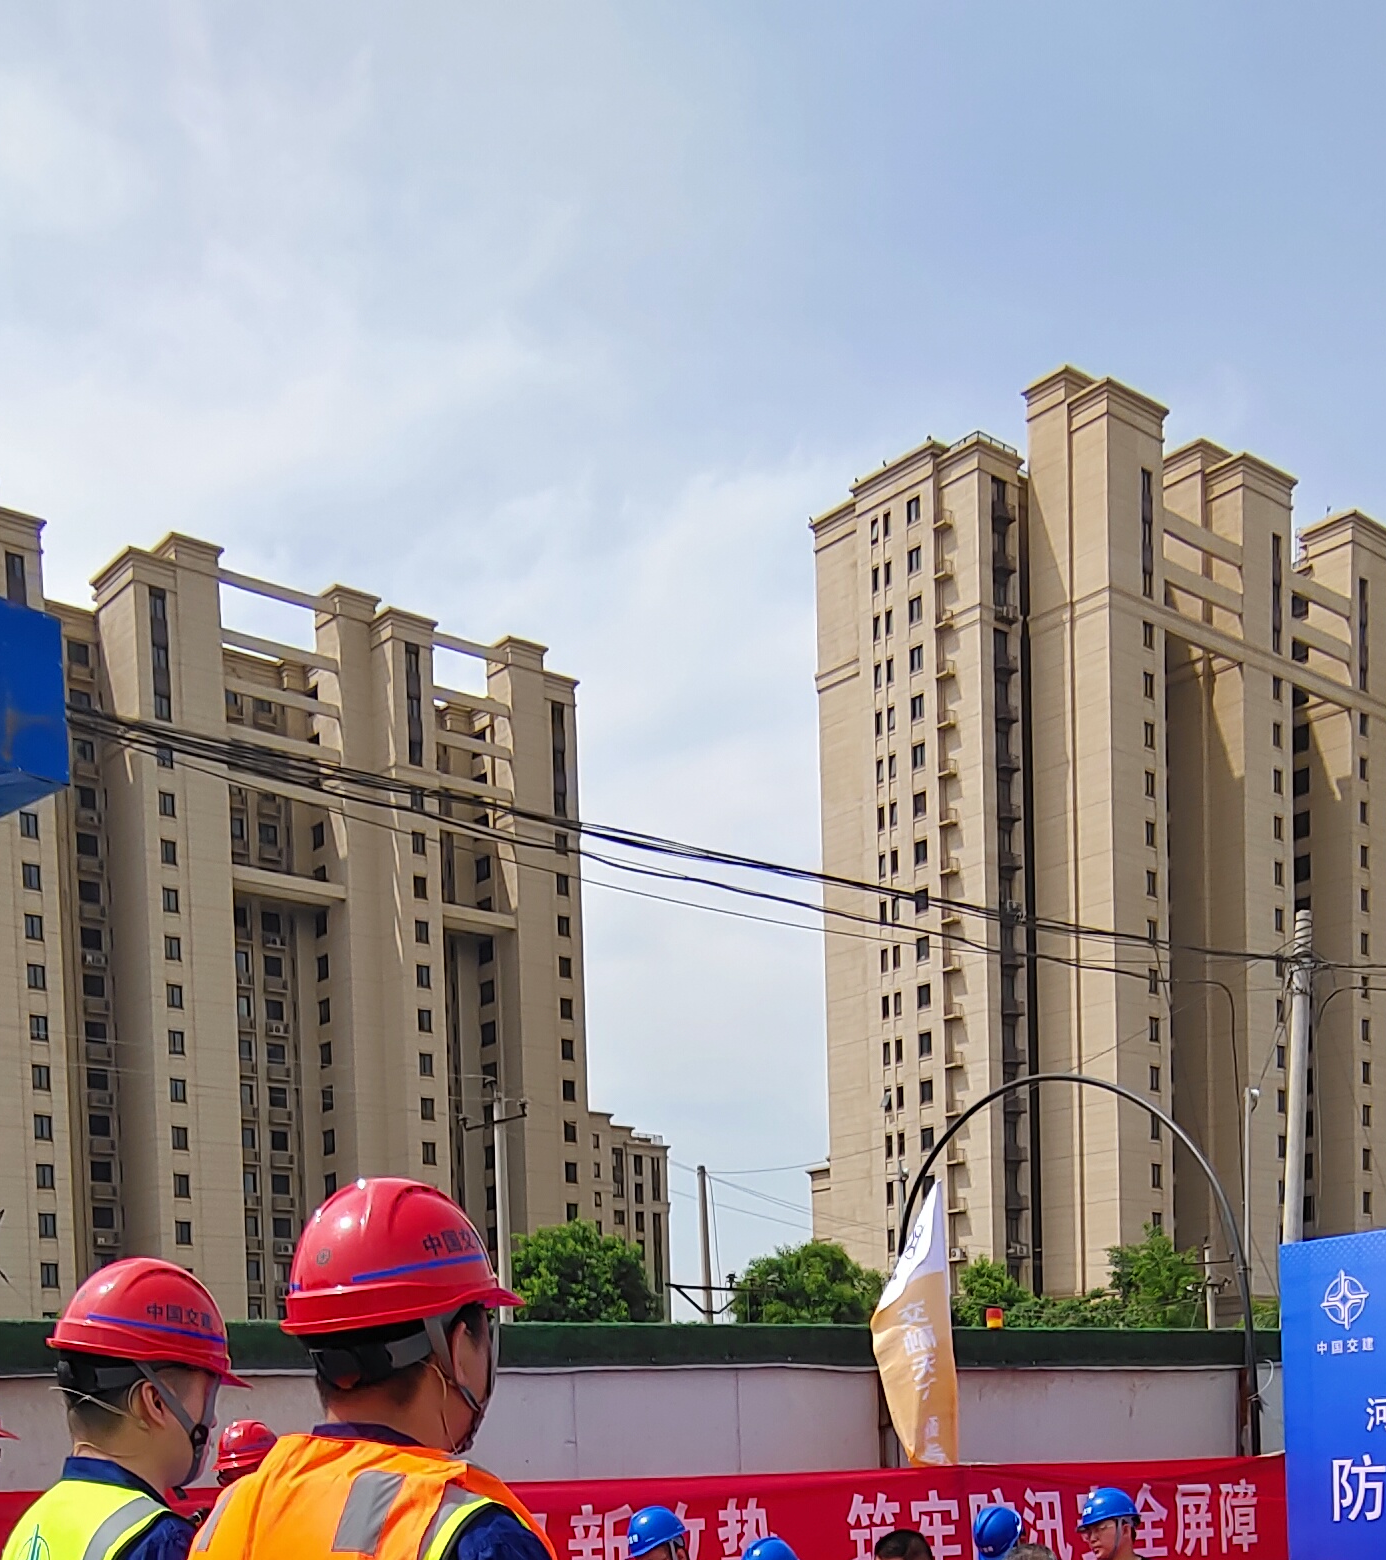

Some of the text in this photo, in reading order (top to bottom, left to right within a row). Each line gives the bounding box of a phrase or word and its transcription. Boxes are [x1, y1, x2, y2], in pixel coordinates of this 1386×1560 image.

[146, 1302, 213, 1330] 中国交建
[1316, 1337, 1375, 1356] 中国交建
